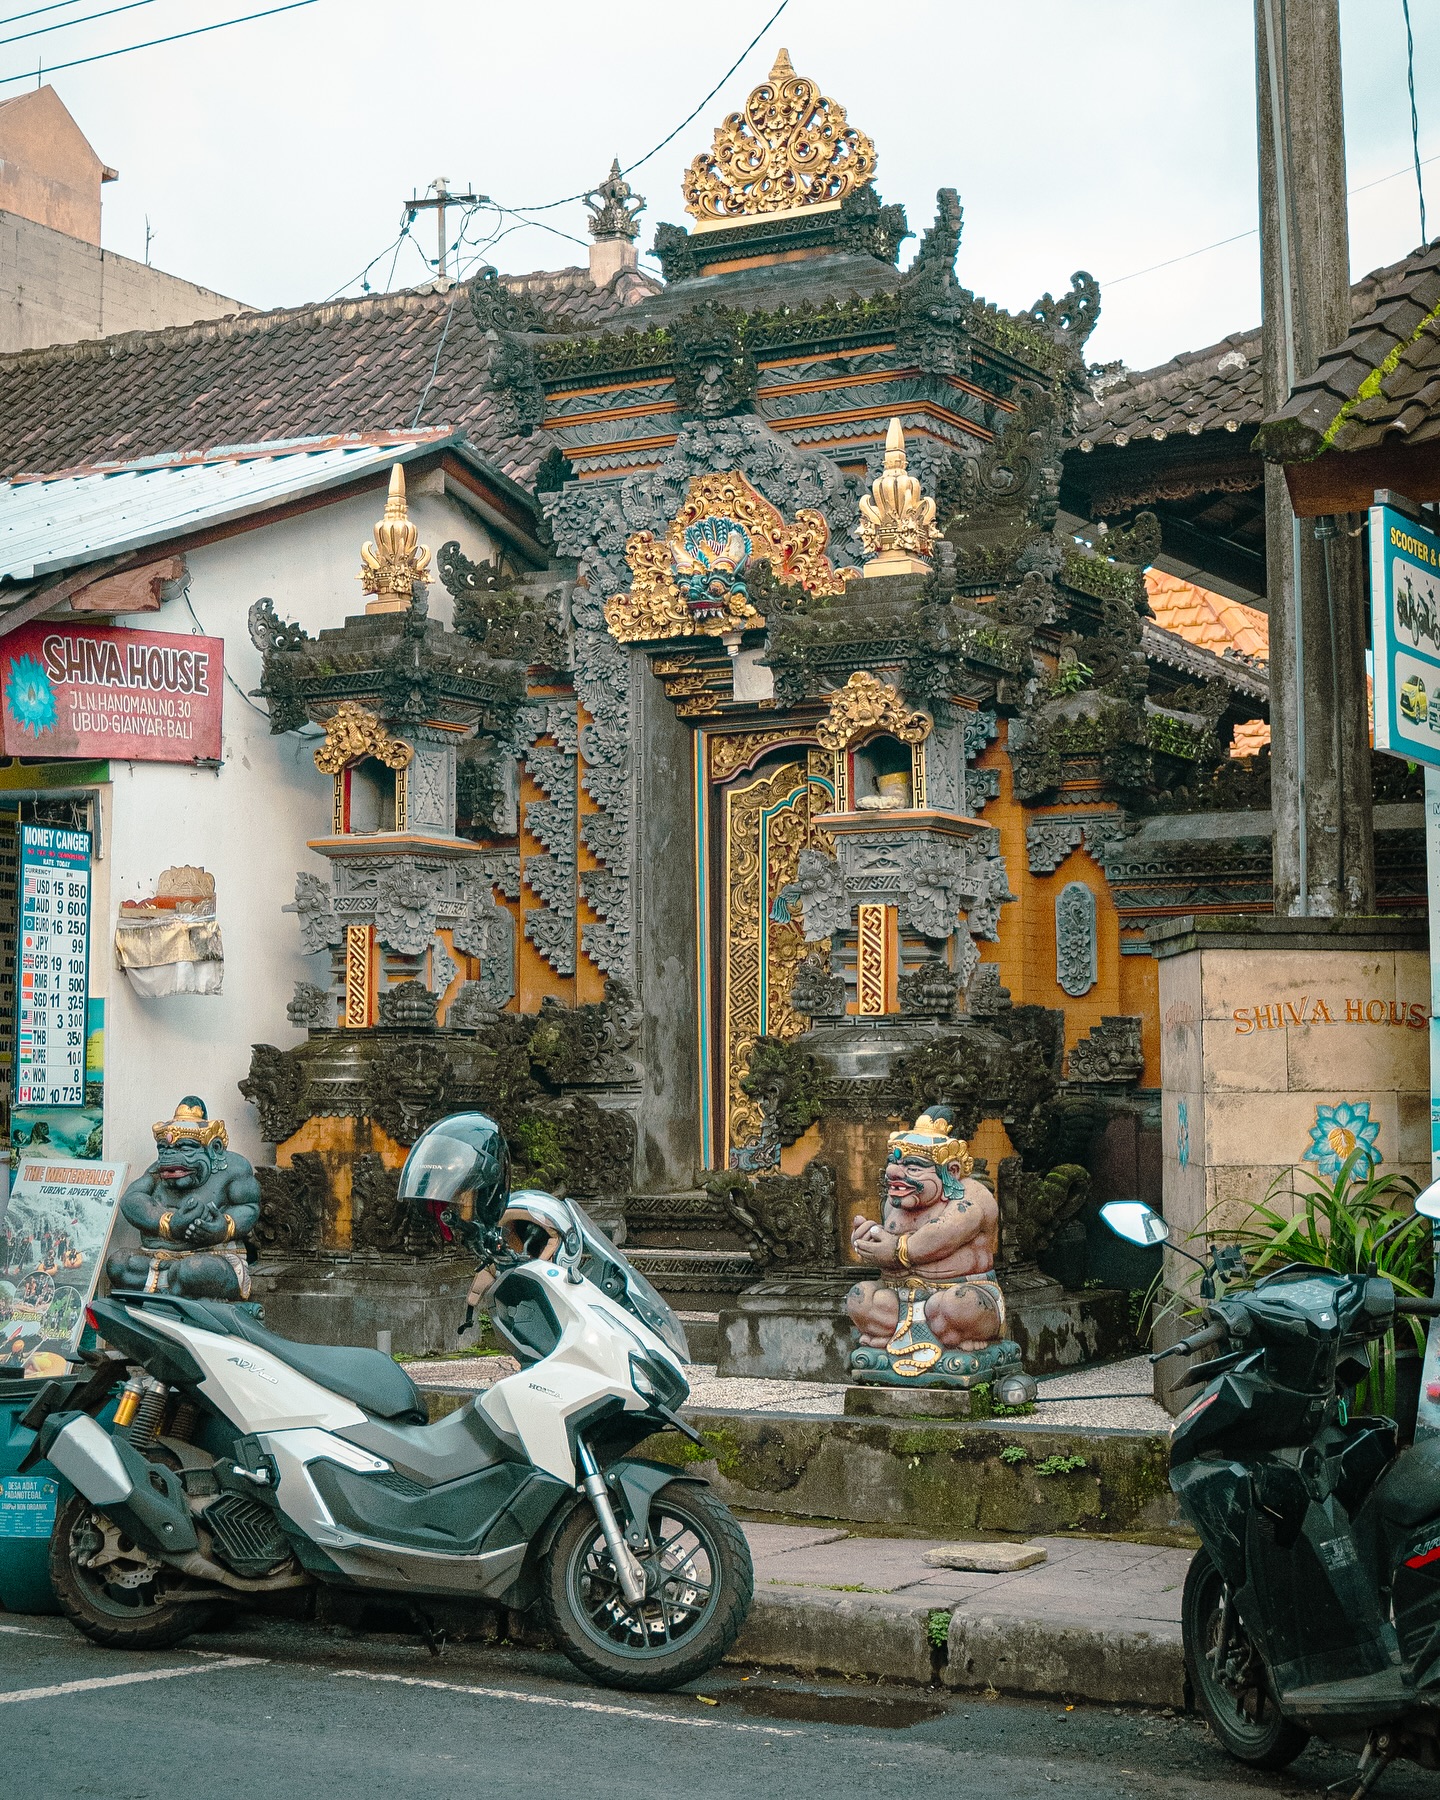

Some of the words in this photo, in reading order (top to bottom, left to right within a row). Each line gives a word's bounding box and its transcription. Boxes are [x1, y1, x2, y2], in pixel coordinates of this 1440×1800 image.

[1390, 526, 1429, 563] SCOOTER
[1430, 548, 1437, 567] &
[42, 635, 126, 688] SHIVA
[127, 644, 209, 697] HOUSE
[24, 826, 55, 848] MONEY
[56, 831, 89, 853] CANGER
[25, 866, 51, 876] CURRENCY
[43, 858, 54, 866] RATE
[56, 860, 71, 868] TODAY
[36, 879, 50, 895] USD
[53, 880, 64, 896] 15
[68, 882, 87, 899] 850
[35, 898, 50, 914] AUD
[57, 900, 64, 914] 9
[67, 901, 87, 917] 600
[35, 916, 50, 933] EURO
[52, 919, 63, 935] 16
[67, 920, 86, 936] 250
[35, 935, 49, 952] JPY
[71, 938, 84, 954] 99
[34, 954, 49, 970] GPB
[50, 956, 62, 972] 19
[68, 959, 84, 975] 100
[34, 973, 48, 989] RMB
[54, 974, 60, 990] 1
[68, 978, 85, 993] 500
[33, 992, 48, 1007] SGD
[50, 993, 60, 1008] 11
[67, 995, 84, 1011] 325
[33, 1010, 47, 1027] MYR
[57, 1013, 64, 1029] 3
[68, 1013, 83, 1028] 300
[1232, 995, 1334, 1036] SHIVA
[33, 1029, 47, 1045] THB
[67, 1031, 81, 1046] 350
[67, 1050, 82, 1066] 100
[32, 1067, 46, 1083] WON
[73, 1068, 80, 1084] 8
[31, 1086, 46, 1102] CAD
[50, 1089, 60, 1104] 10
[62, 1086, 82, 1102] 725
[23, 1165, 45, 1182] THE
[44, 1166, 115, 1187] WATERFALLS
[39, 1185, 67, 1196] TUBING
[67, 1187, 109, 1198] ADVENTURE
